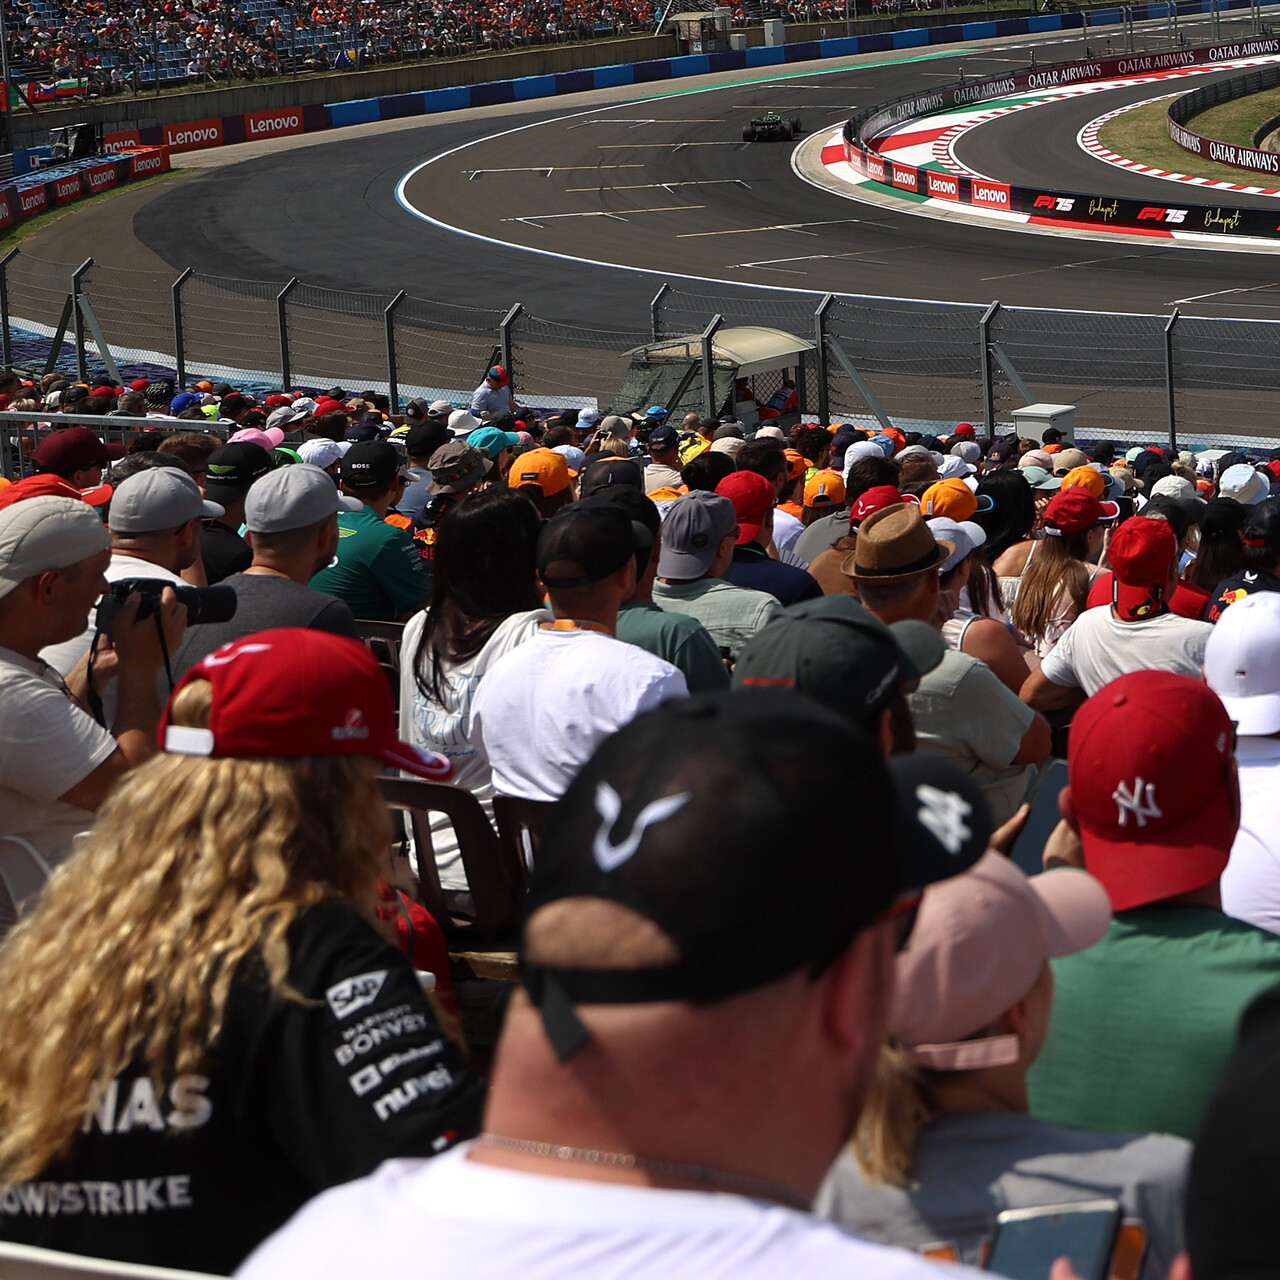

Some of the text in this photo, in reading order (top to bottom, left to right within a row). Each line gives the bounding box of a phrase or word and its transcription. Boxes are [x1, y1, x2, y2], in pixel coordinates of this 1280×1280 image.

[1209, 39, 1279, 61] QATAR AIRWAYS
[1118, 50, 1195, 74] QATAR AIRWAYS
[1028, 64, 1101, 88] QATAR AIRWAYS
[953, 78, 1015, 104] QATAR AIRWAYS
[250, 115, 299, 134] Lenovo
[168, 127, 218, 146] Lenovo
[134, 156, 161, 173] Lenovo
[1209, 141, 1279, 172] QATAR AIRWAYS
[89, 169, 115, 188] Lenovo
[893, 167, 916, 186] Lenovo
[929, 175, 956, 195] Lenovo
[57, 180, 80, 198] Lenovo
[974, 185, 1007, 204] Lenovo
[21, 191, 46, 211] Lenovo
[1112, 776, 1162, 827] NY
[331, 975, 384, 1011] SAP
